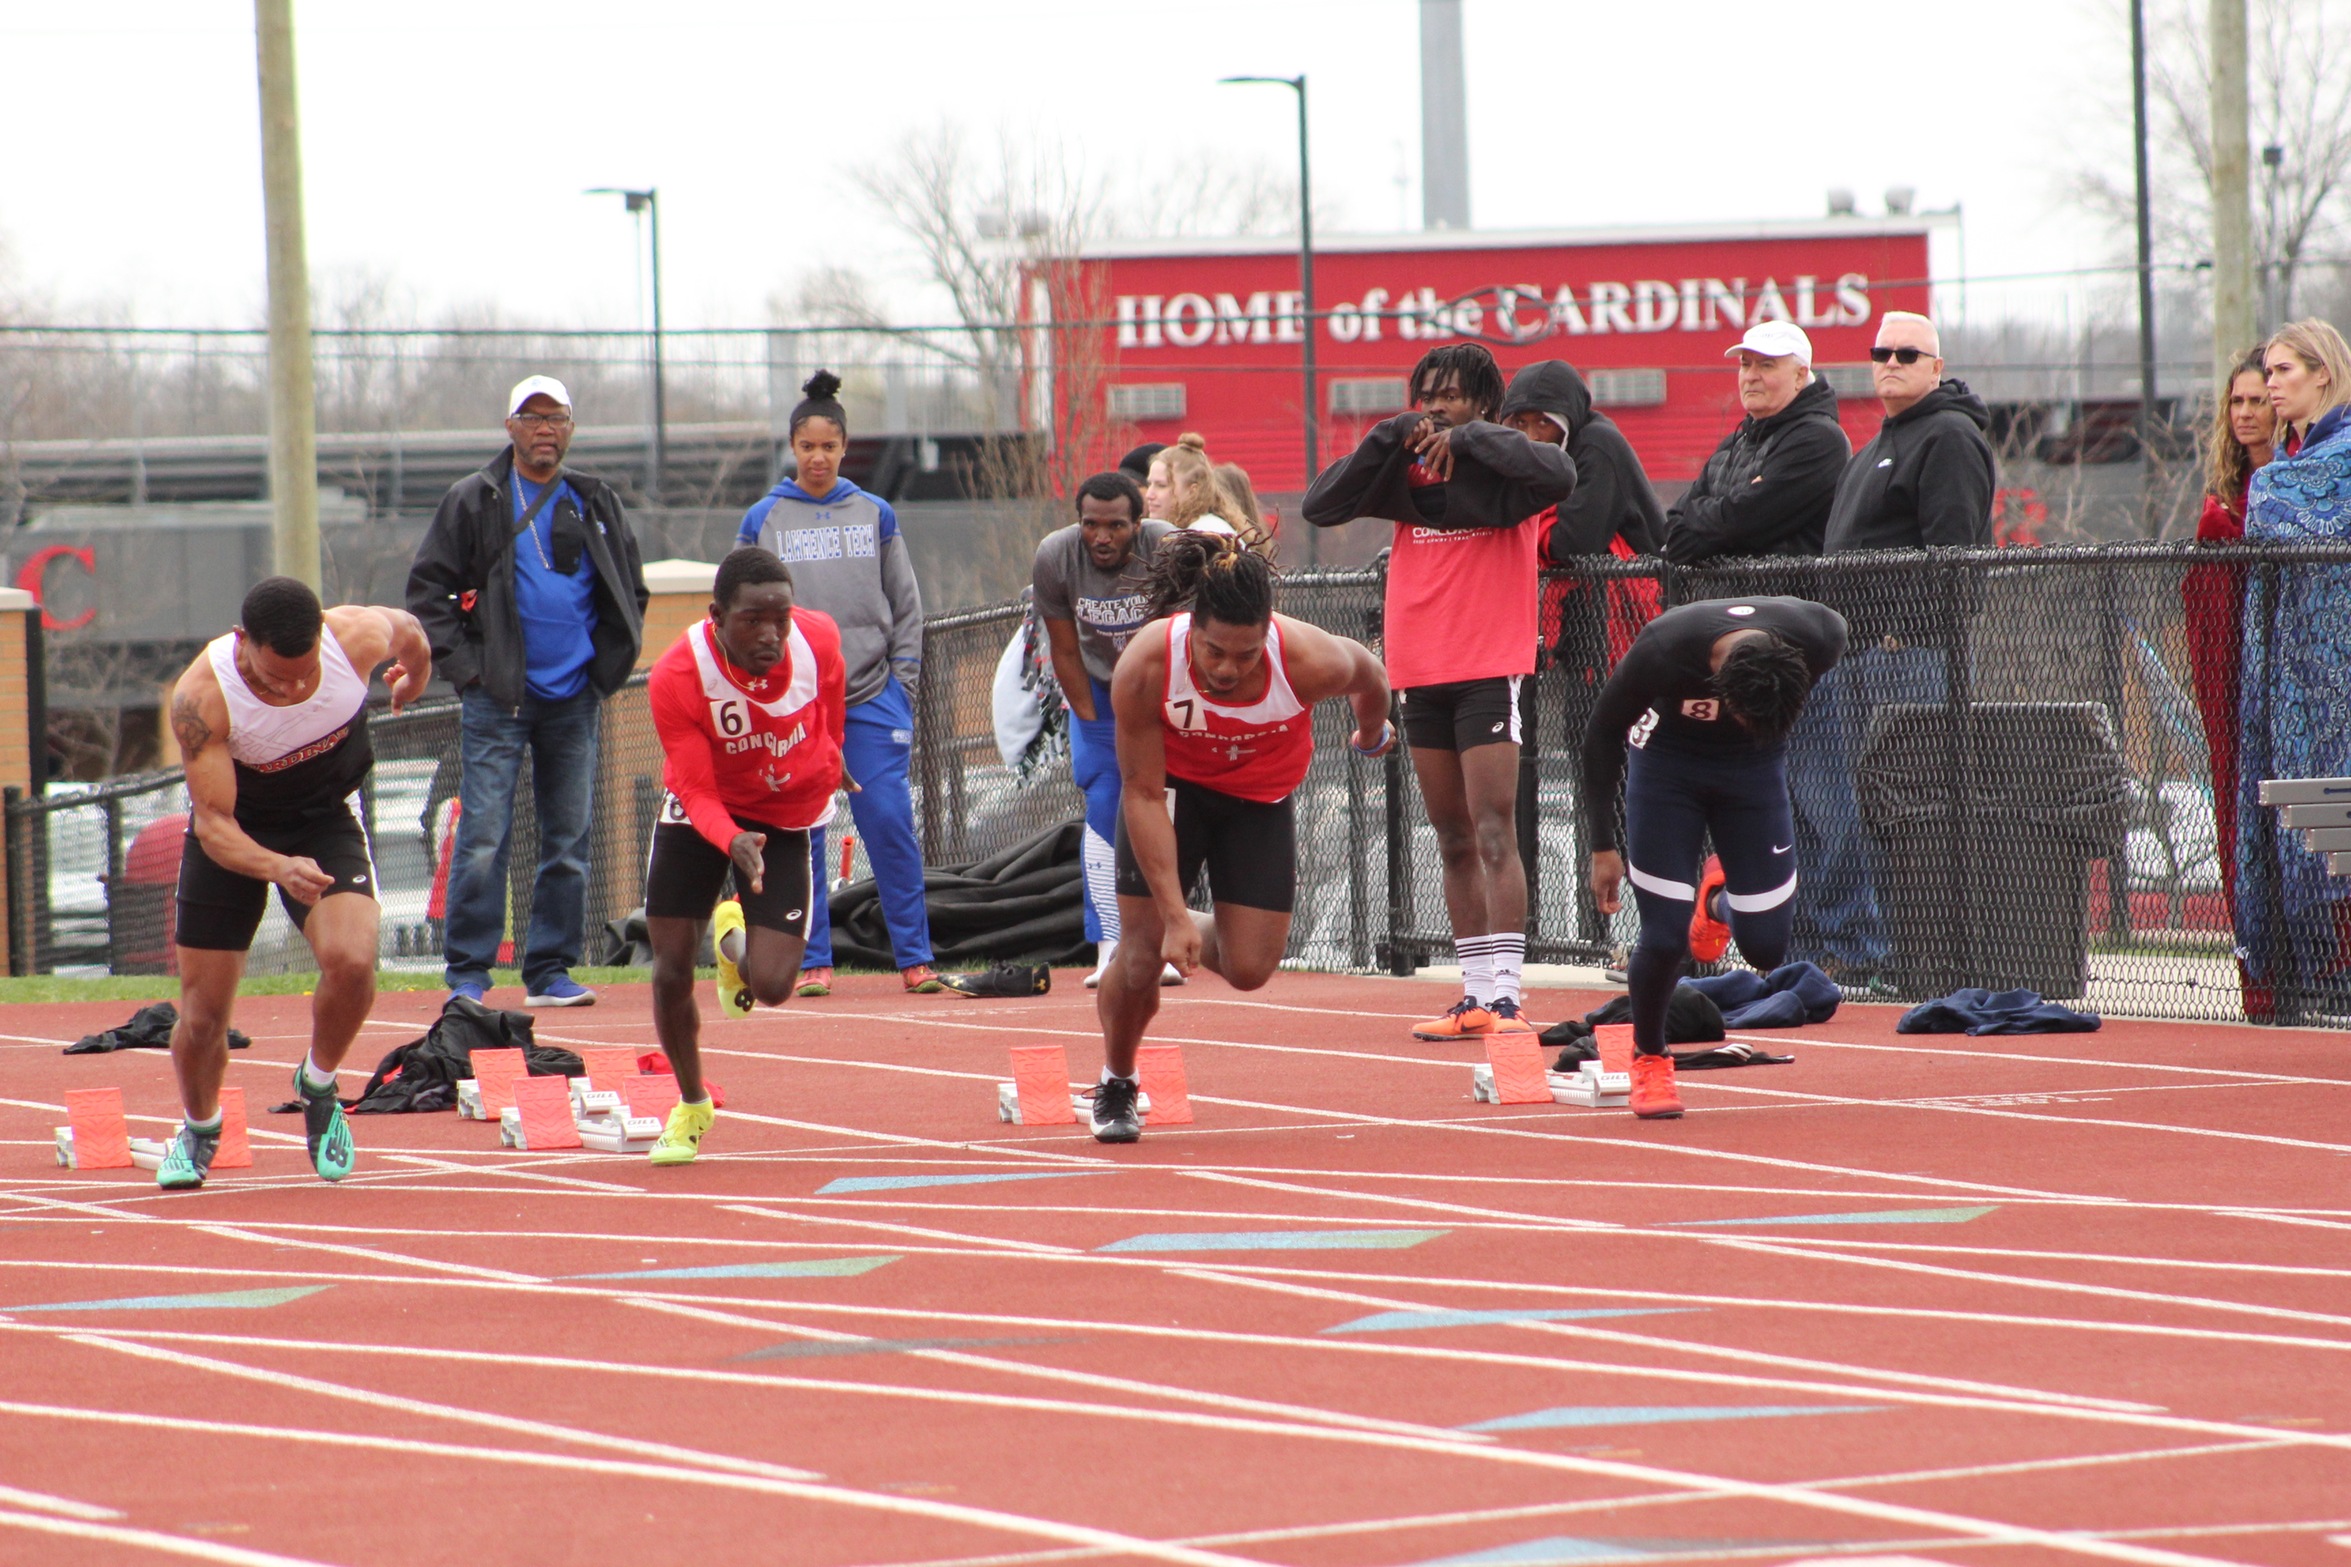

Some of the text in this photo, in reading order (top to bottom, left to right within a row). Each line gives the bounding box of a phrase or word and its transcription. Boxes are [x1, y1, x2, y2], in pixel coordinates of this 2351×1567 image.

[1116, 272, 1871, 347] HOME of the CARDINALS
[776, 524, 875, 563] LAWRENCE TECH
[15, 545, 96, 630] C
[1078, 597, 1121, 610] CREATE
[720, 700, 743, 736] 6
[1173, 699, 1194, 729] 7
[1689, 701, 1712, 720] 8
